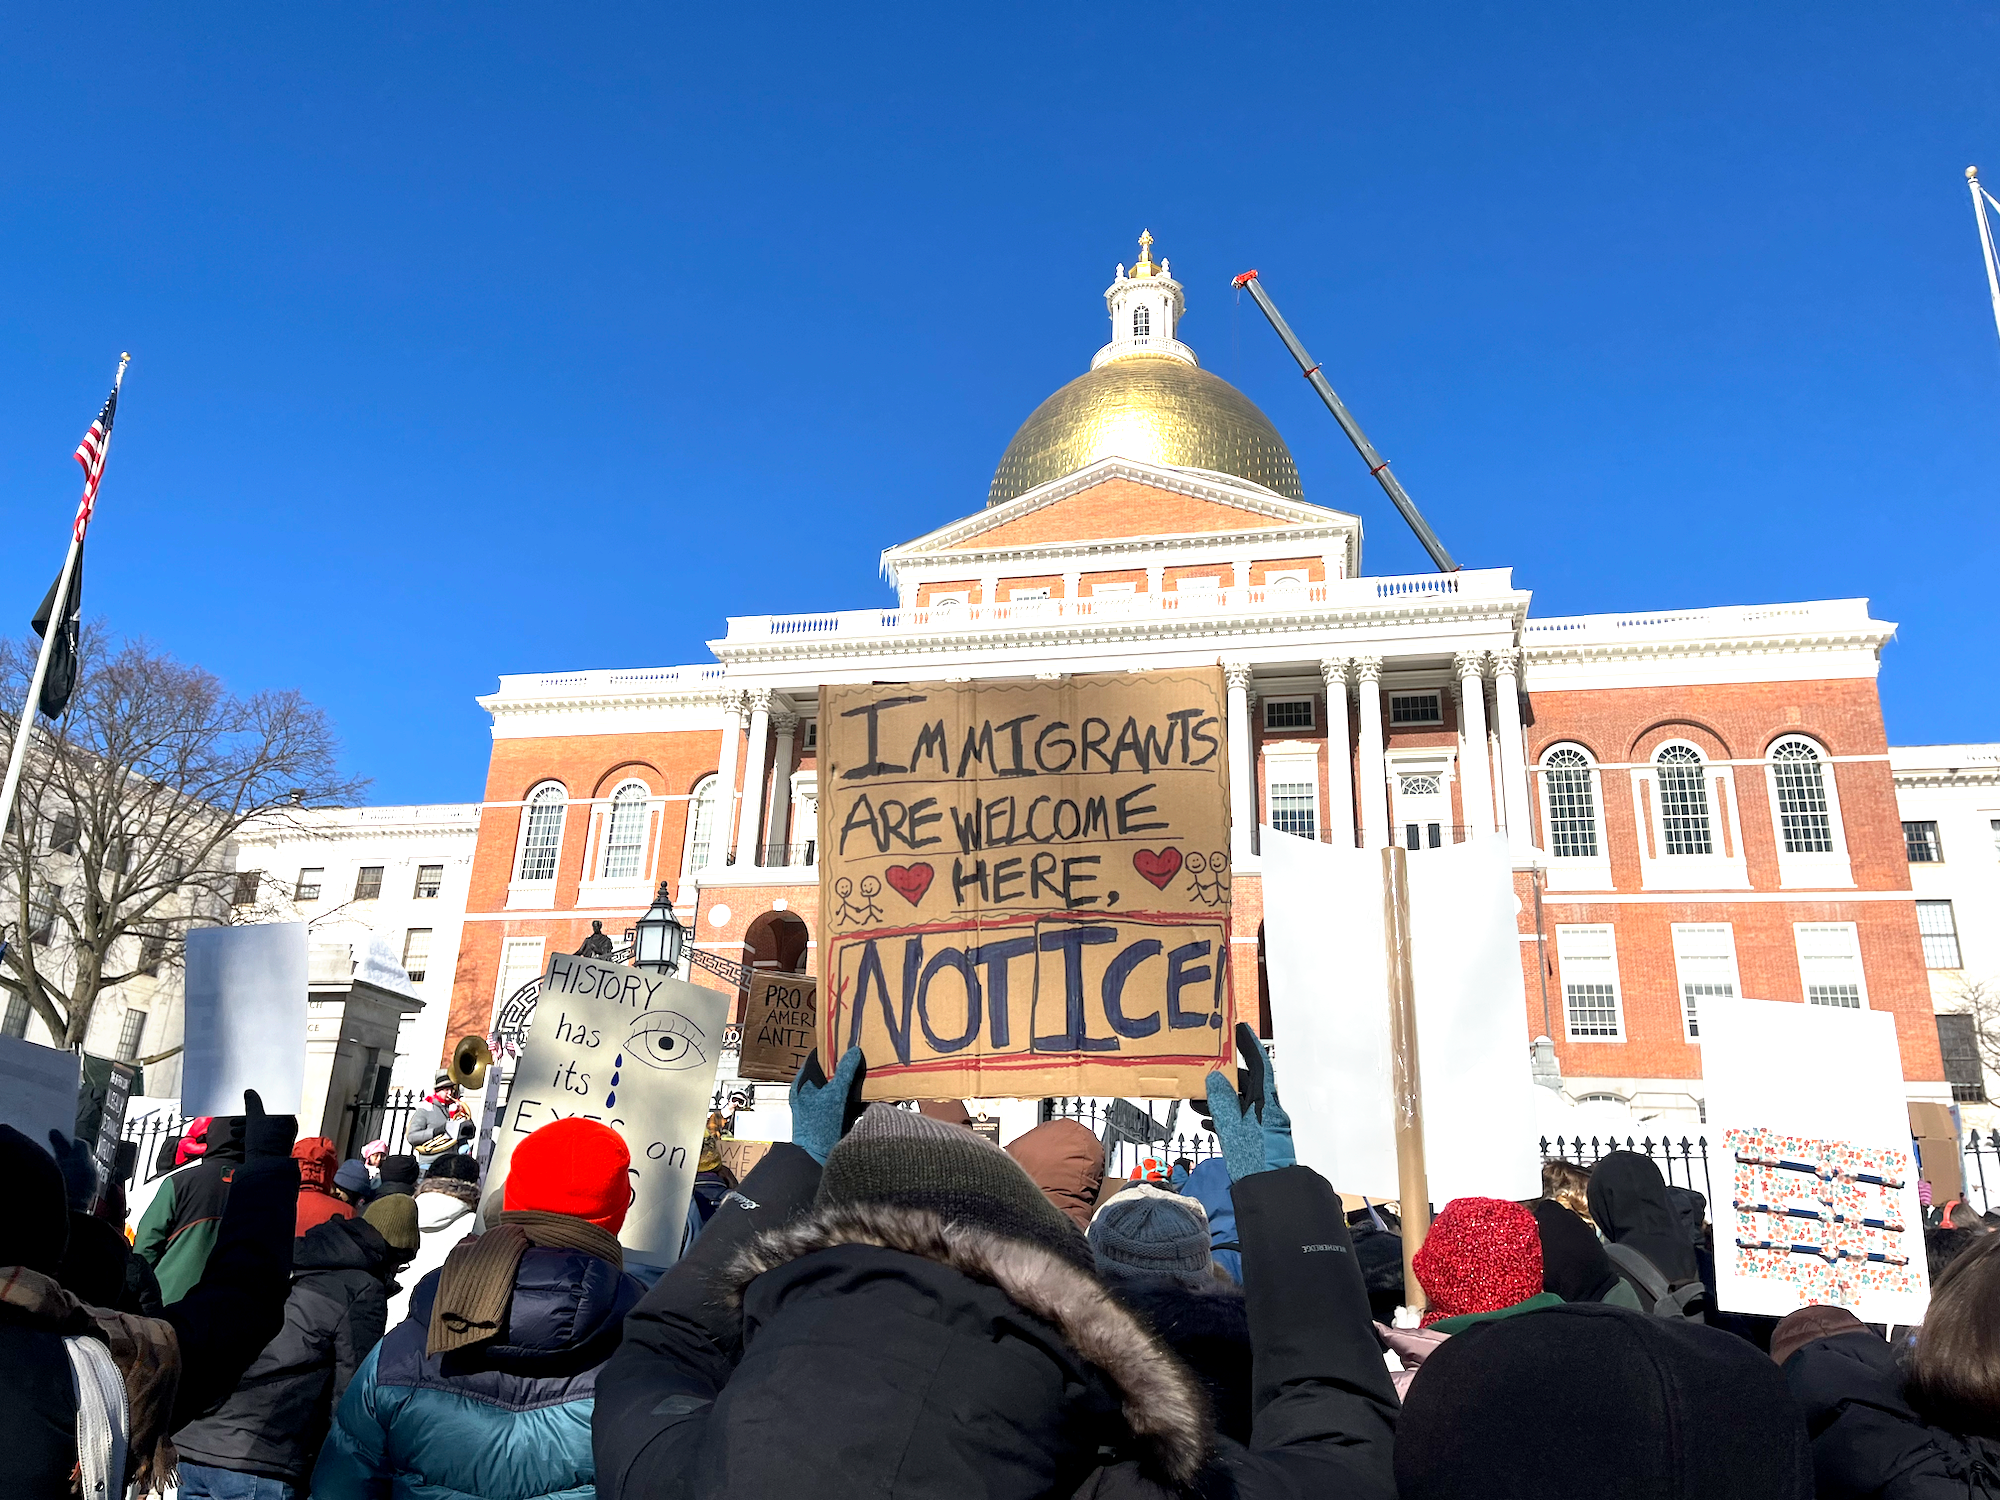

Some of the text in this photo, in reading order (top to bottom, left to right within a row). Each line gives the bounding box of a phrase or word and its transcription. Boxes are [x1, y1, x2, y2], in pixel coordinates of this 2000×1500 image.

[841, 695, 1219, 779] IMMIGRANTS
[840, 784, 1169, 856] ARE WELCOME
[952, 851, 1120, 909] HERE,
[548, 959, 663, 1011] HISTORY
[765, 984, 801, 1009] PRO
[555, 1012, 601, 1048] has
[757, 1026, 810, 1048] ANTI
[553, 1060, 591, 1096] its
[646, 1141, 686, 1169] on
[720, 1144, 753, 1161] WE
